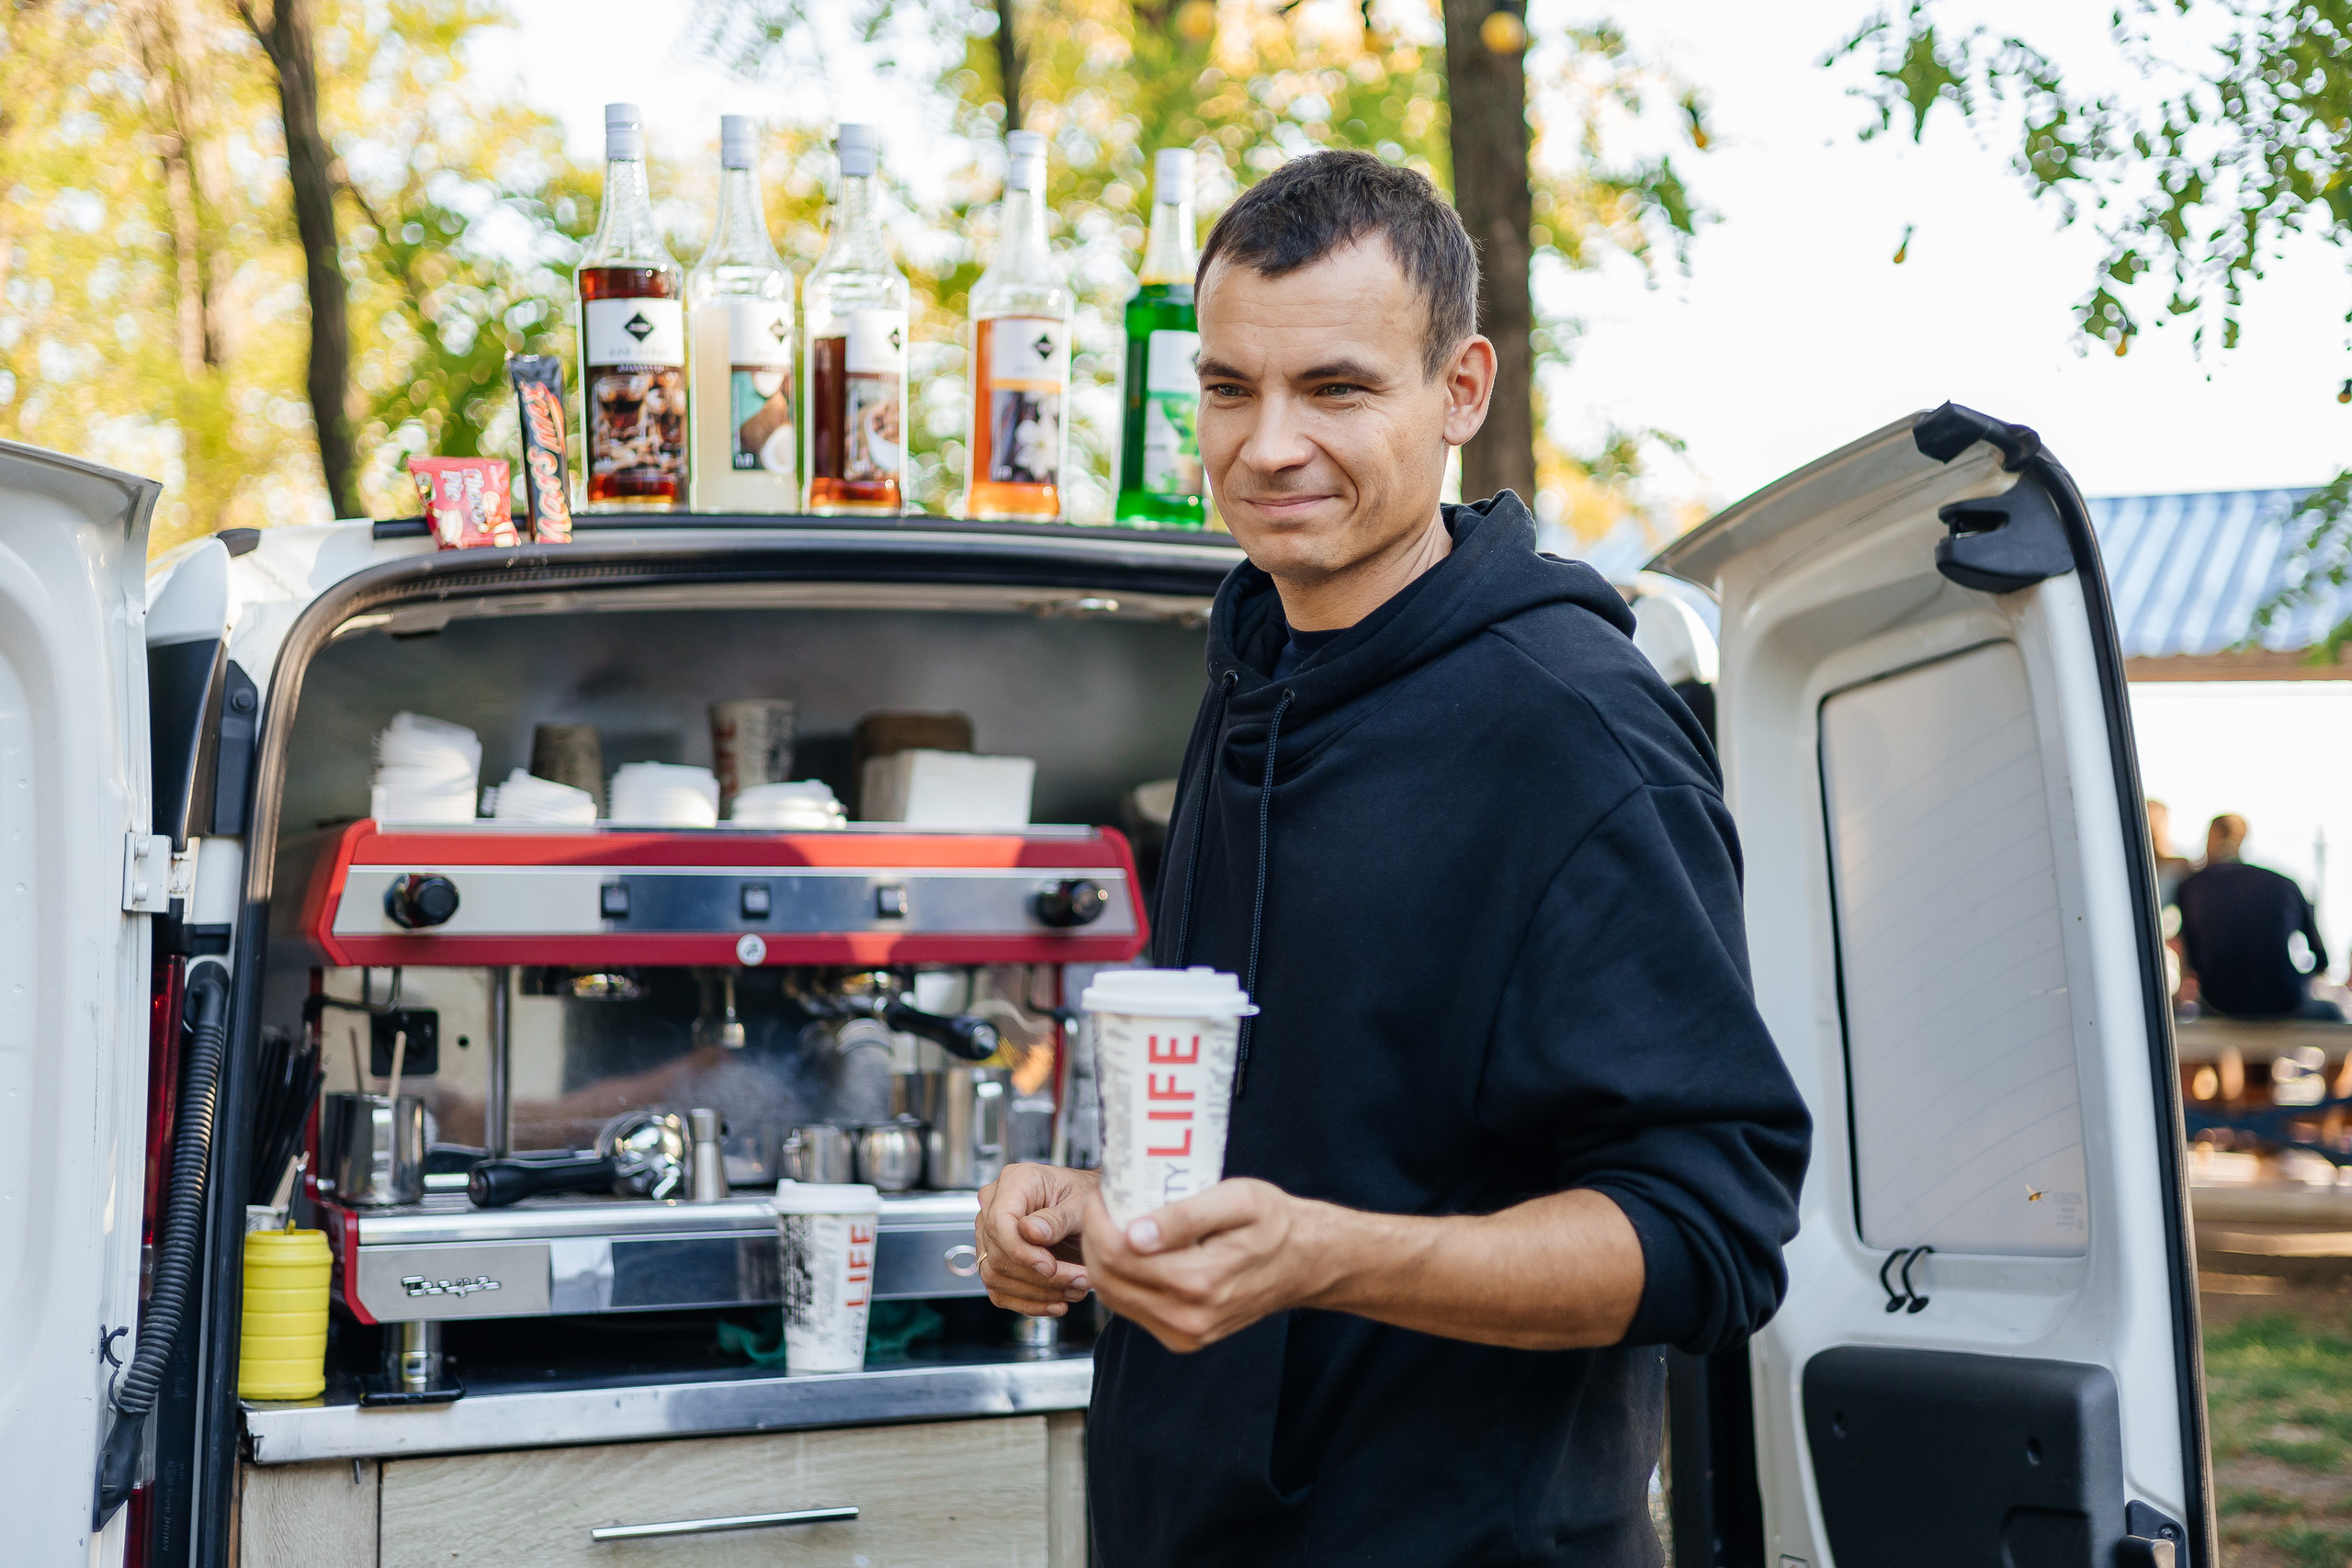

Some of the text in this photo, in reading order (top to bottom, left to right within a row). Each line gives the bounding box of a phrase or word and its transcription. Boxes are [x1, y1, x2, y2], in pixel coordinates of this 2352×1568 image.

[440, 469, 463, 502] Pie
[1147, 1034, 1200, 1156] LIFE
[846, 1224, 872, 1306] LIFE
